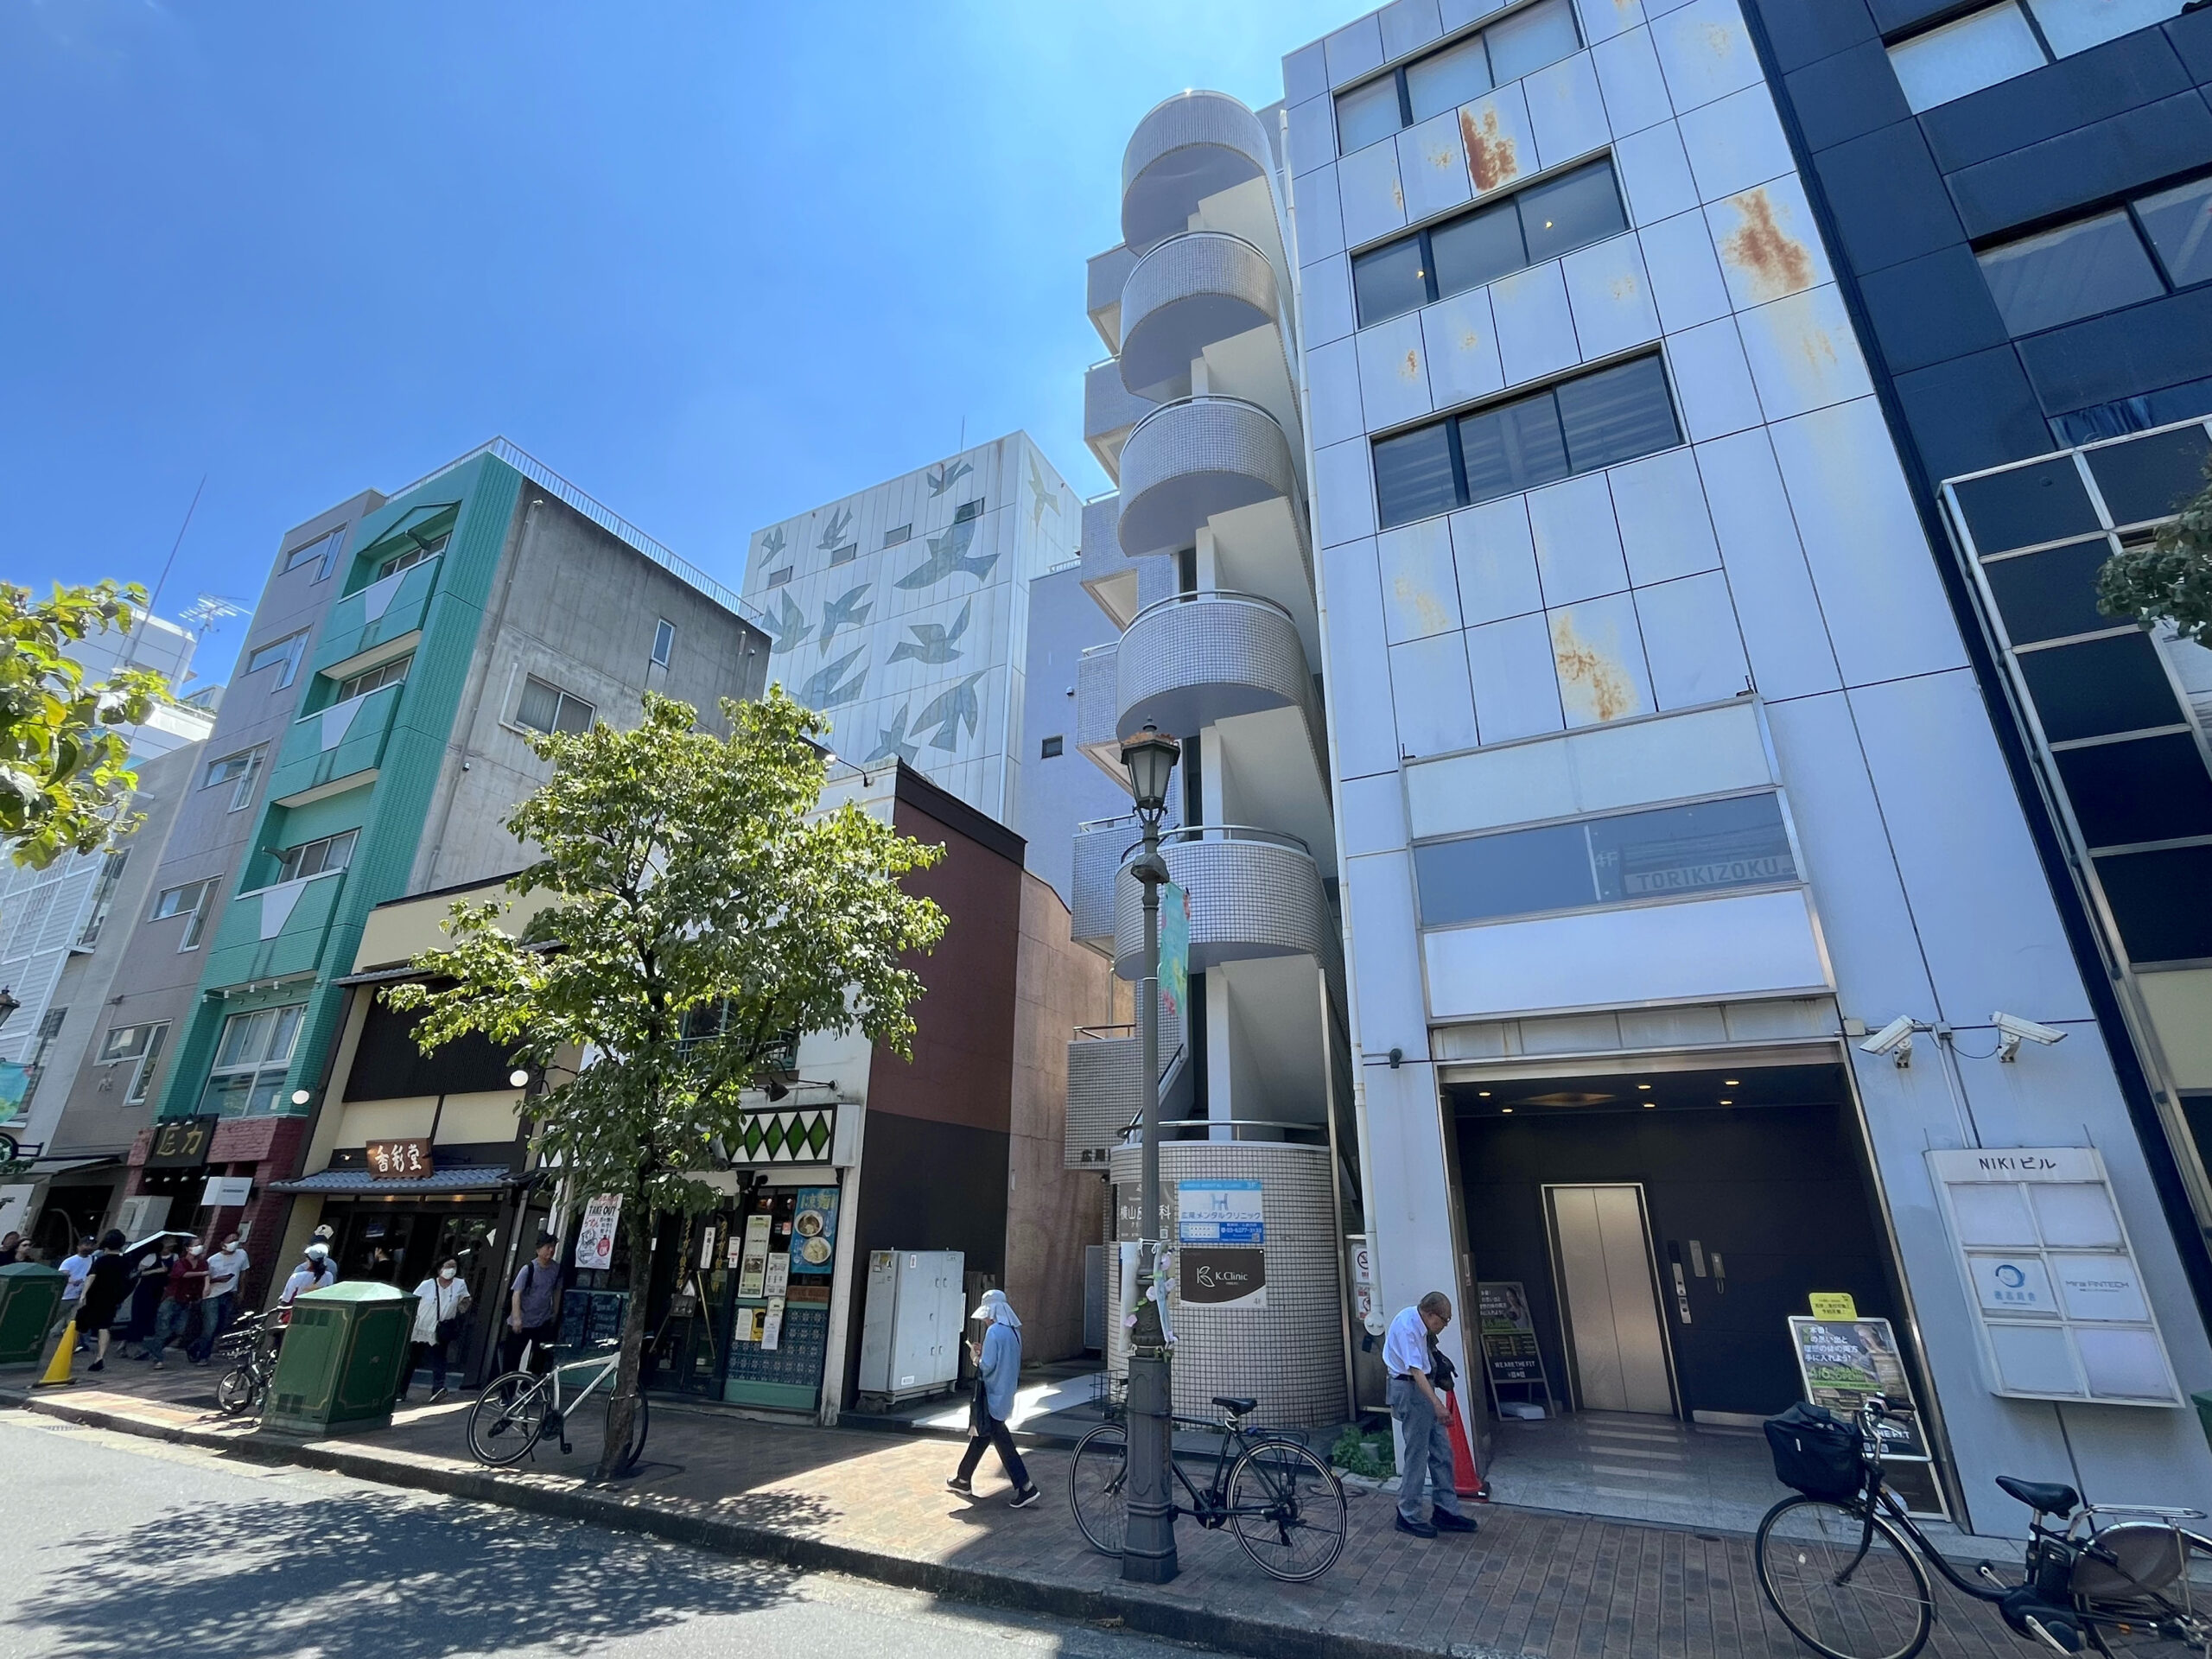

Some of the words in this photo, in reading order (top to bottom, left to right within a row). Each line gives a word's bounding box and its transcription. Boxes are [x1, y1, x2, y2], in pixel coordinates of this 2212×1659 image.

[1636, 859, 1779, 891] TORIKIZOKU
[588, 1206, 602, 1215] TAKE
[603, 1206, 616, 1215] OUT
[1215, 1271, 1249, 1281] K.Clinic
